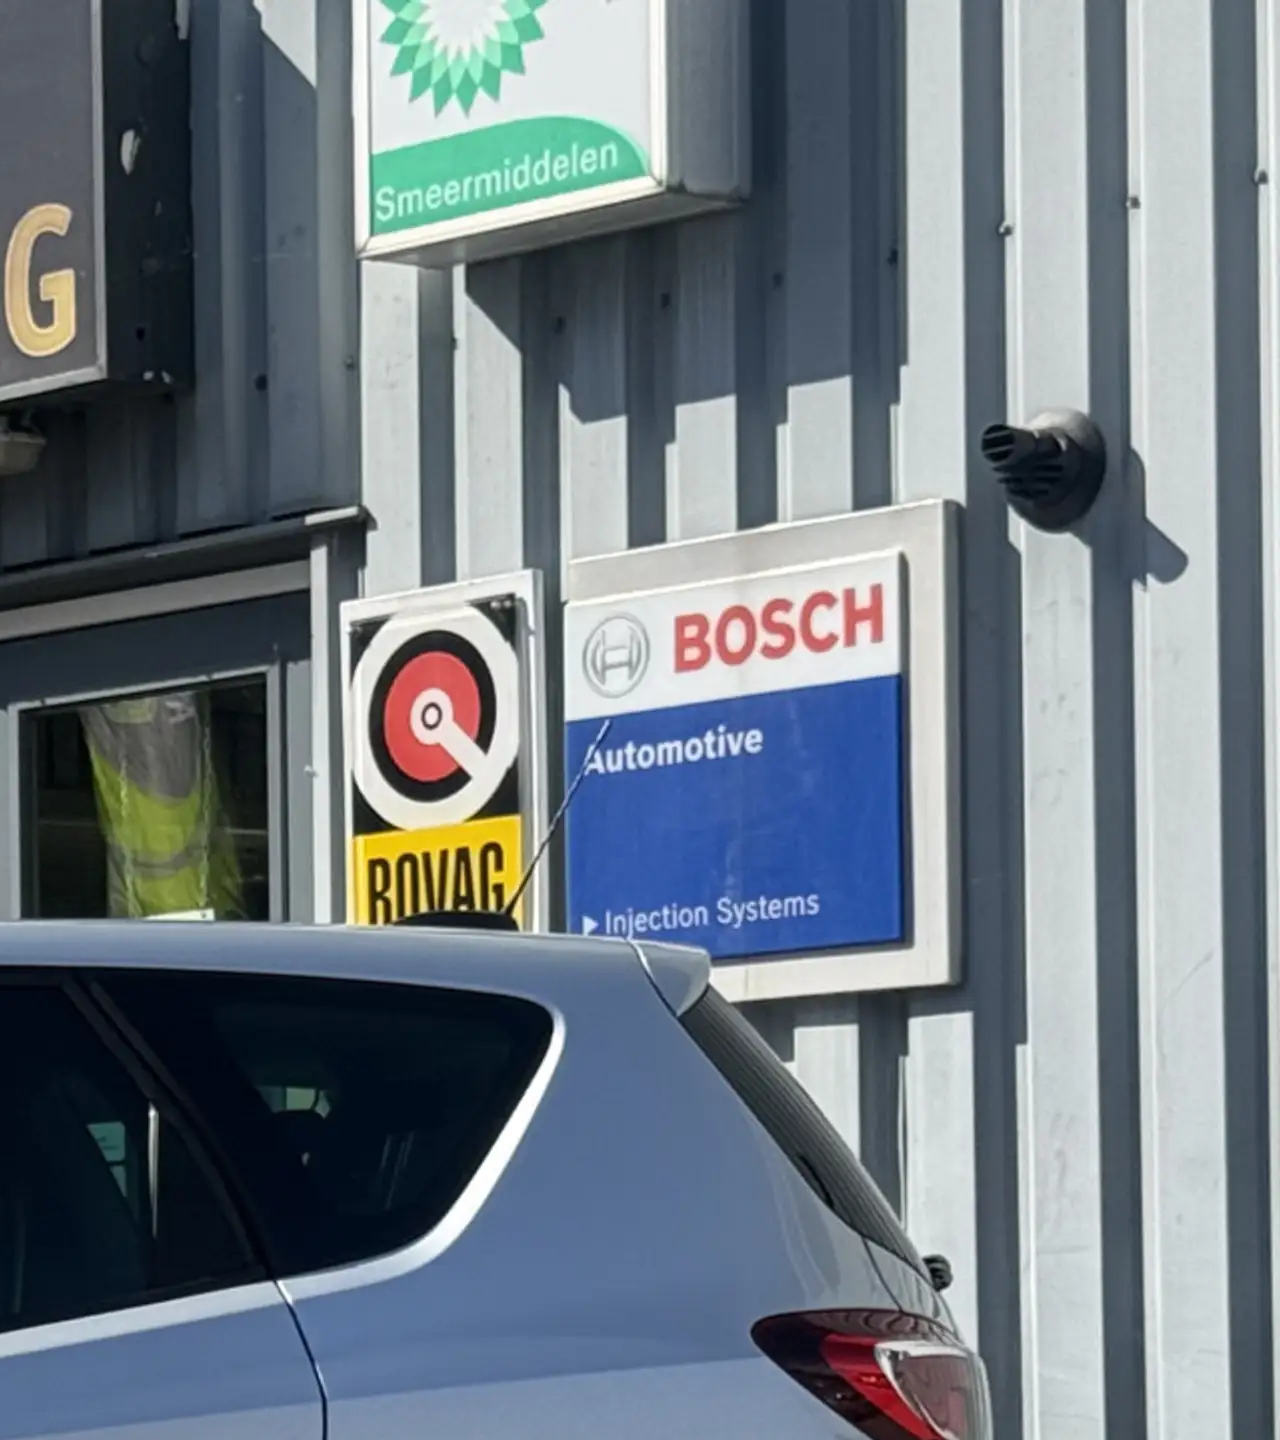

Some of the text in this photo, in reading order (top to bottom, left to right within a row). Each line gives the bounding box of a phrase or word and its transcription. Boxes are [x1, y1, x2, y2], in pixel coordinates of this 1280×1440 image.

[374, 140, 618, 222] Smeermiddelen
[673, 583, 884, 673] BOSCH
[583, 723, 764, 776] Automotive
[367, 841, 506, 925] ROVAG
[604, 894, 820, 939] Injection Systems
